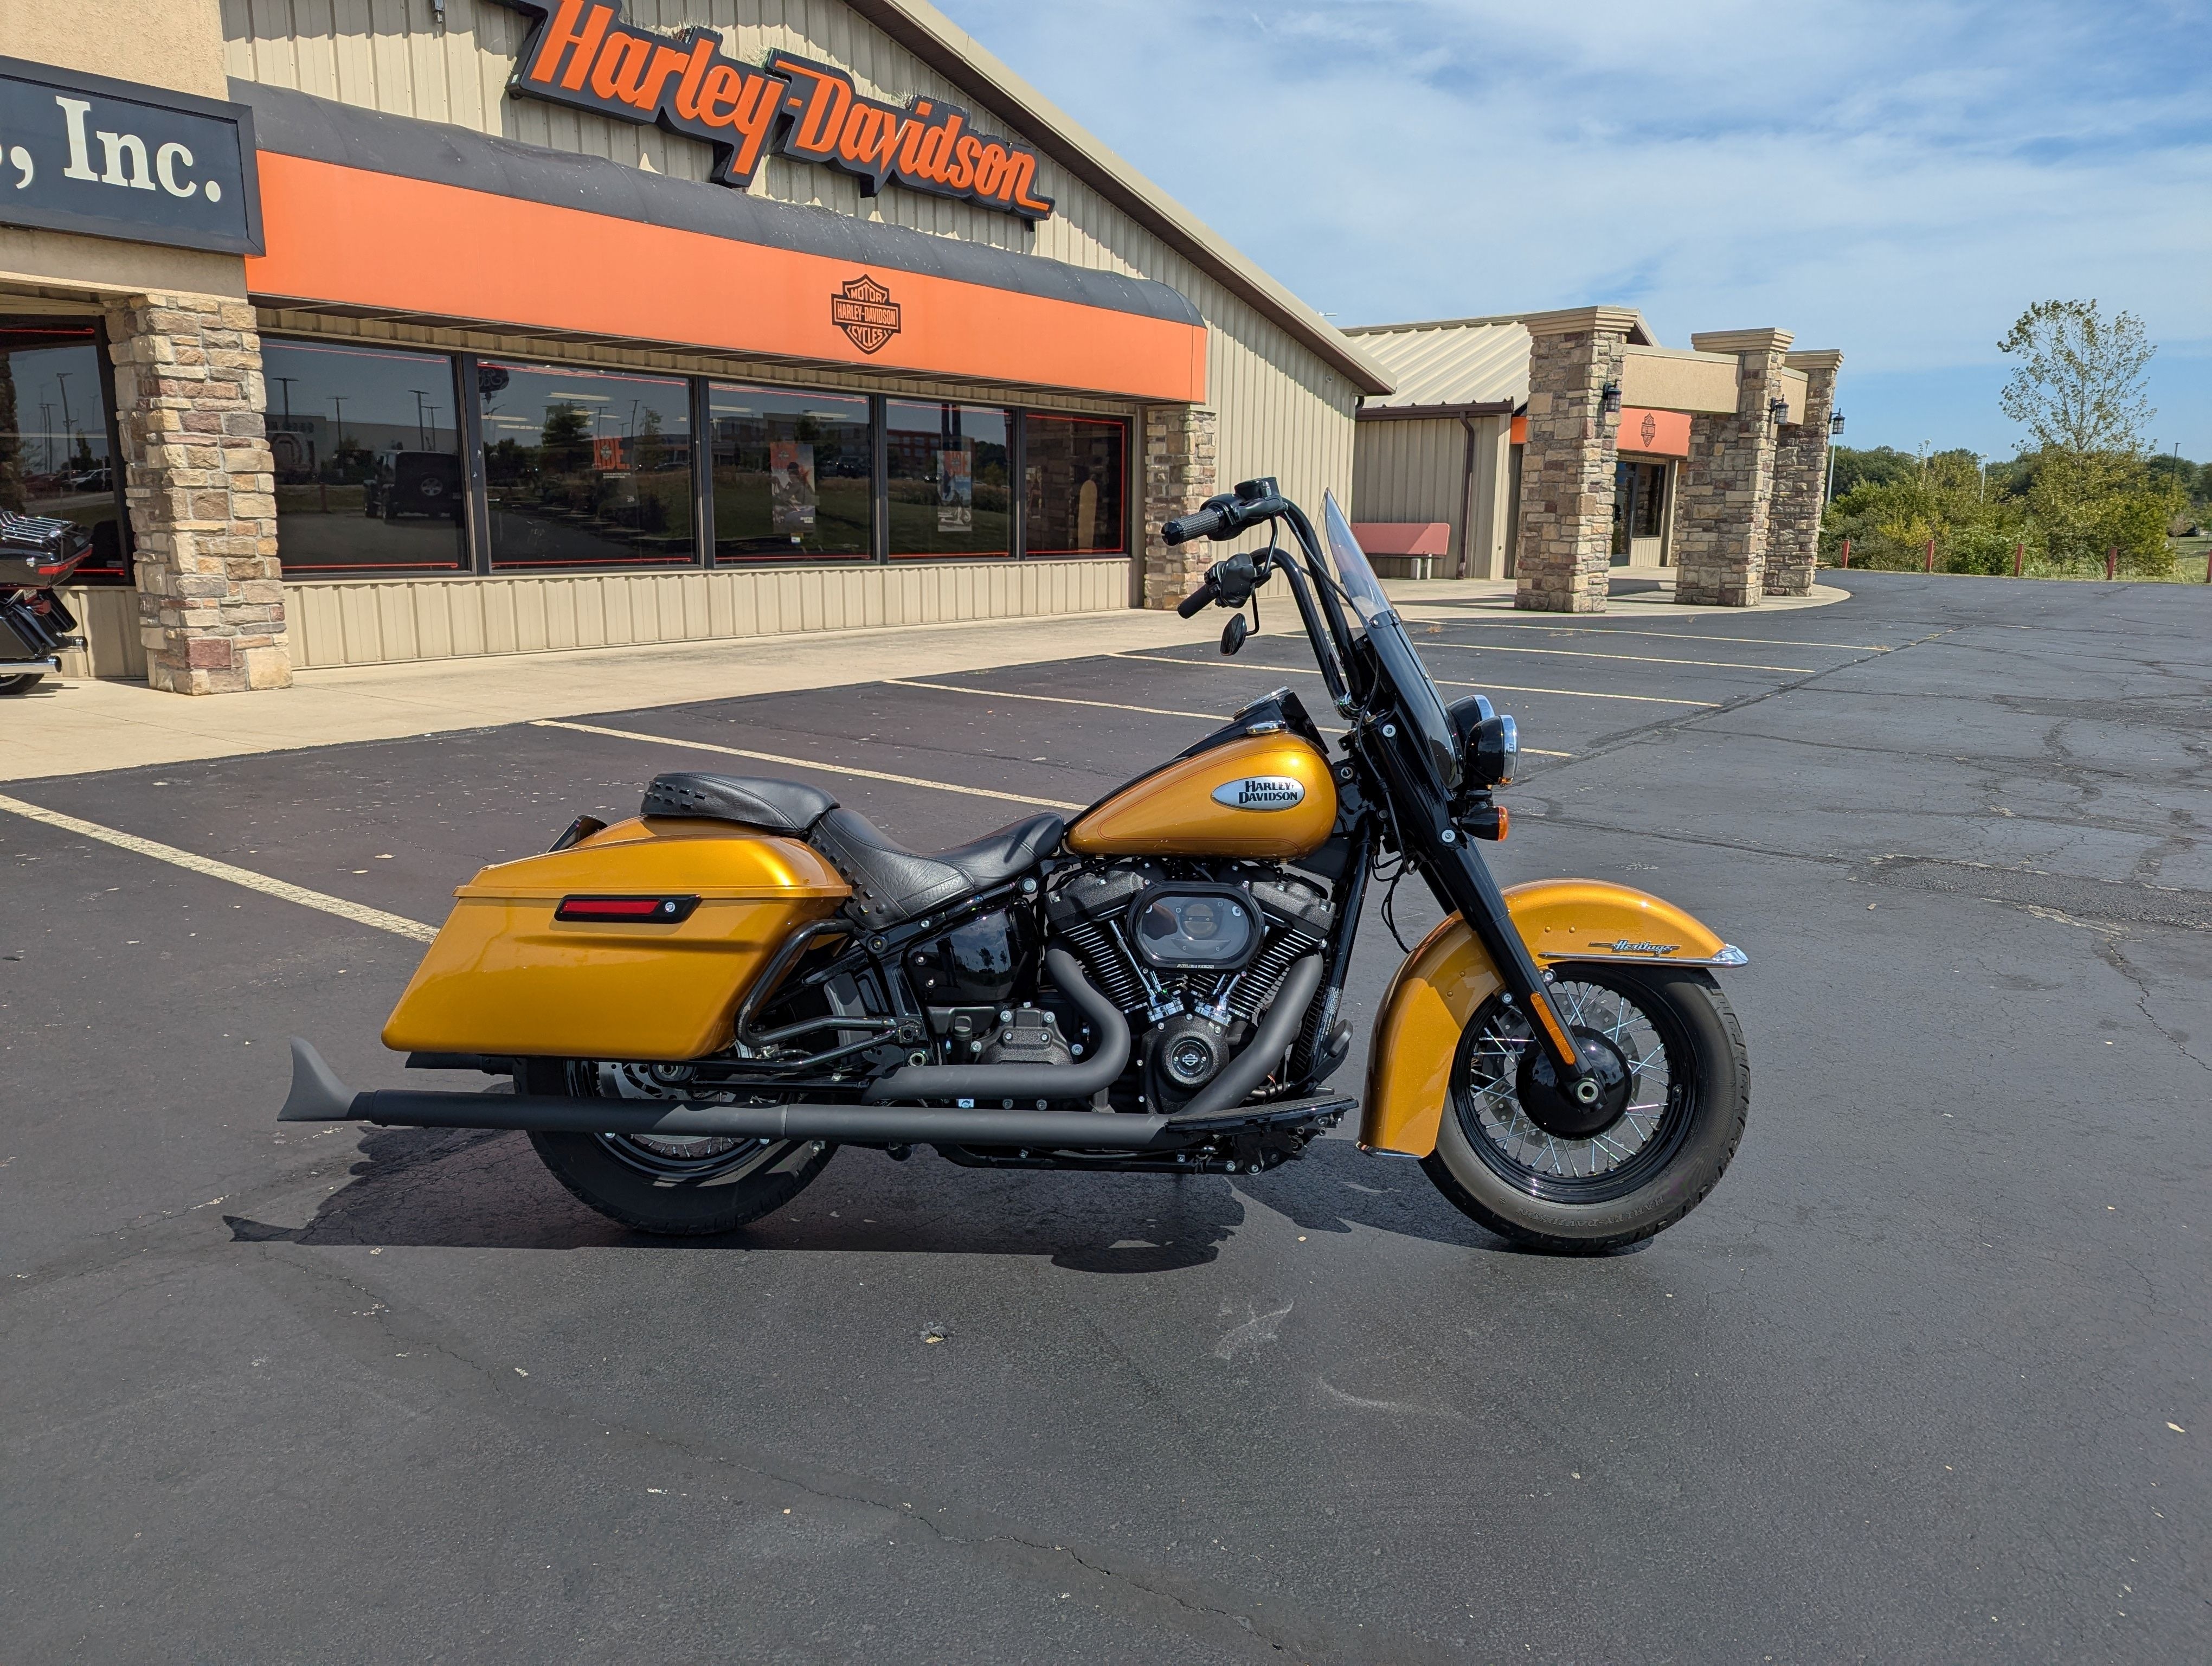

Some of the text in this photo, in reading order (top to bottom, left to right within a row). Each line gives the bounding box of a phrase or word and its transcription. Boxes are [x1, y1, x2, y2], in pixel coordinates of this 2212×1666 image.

[55, 95, 221, 202] Inc.
[851, 284, 882, 303] MOTOR
[837, 303, 896, 325] HARLEY-DAVIDSON
[852, 325, 883, 347] CYCLES
[1239, 792, 1297, 804] DAVIDSON
[1615, 939, 1673, 955] Heritage
[1515, 1195, 1666, 1227] HARLEY-DAVIDSON
